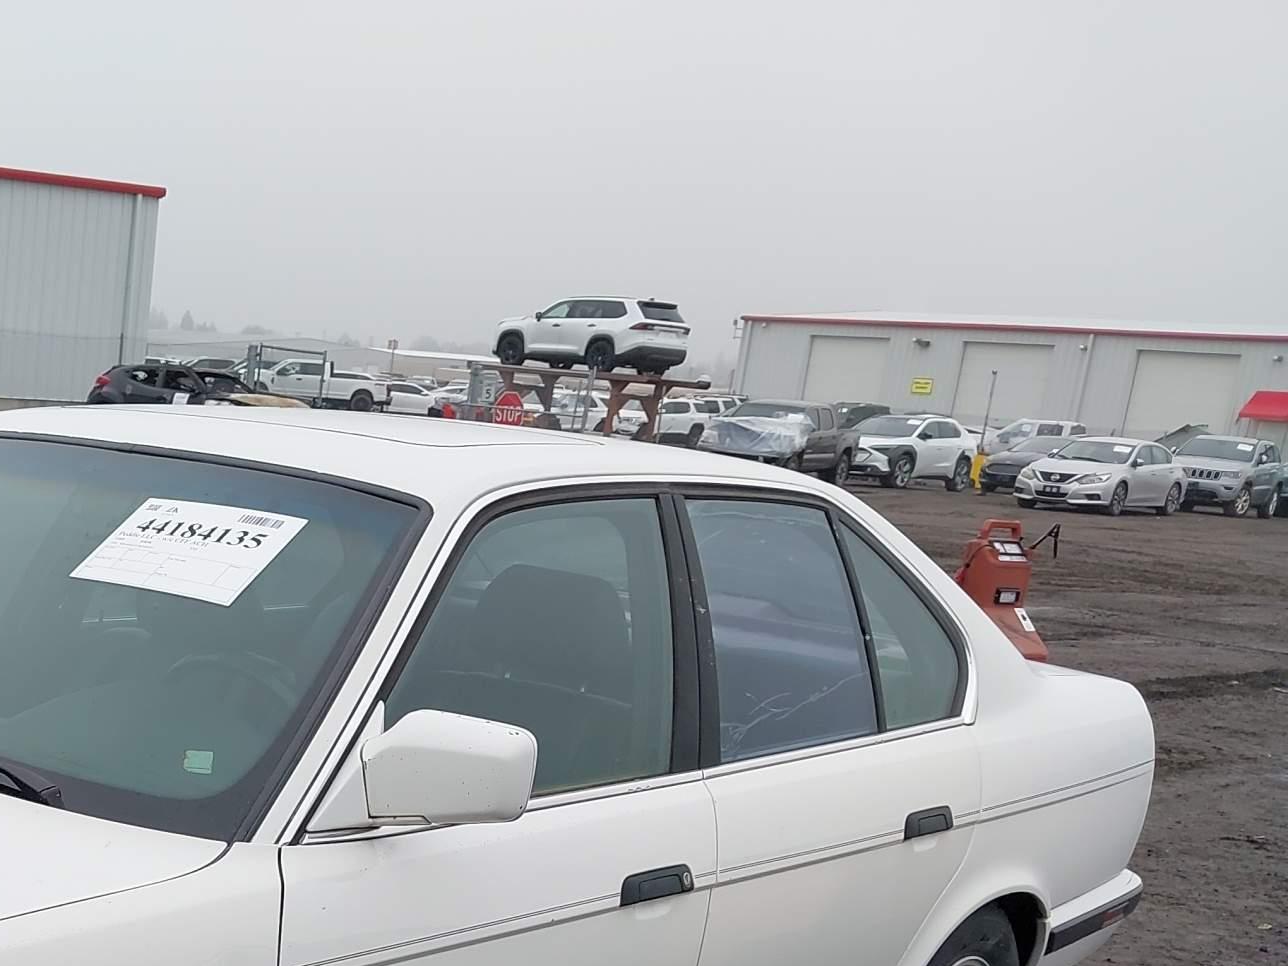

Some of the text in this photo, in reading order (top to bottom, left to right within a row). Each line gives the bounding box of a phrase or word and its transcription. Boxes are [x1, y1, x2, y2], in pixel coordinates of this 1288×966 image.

[485, 388, 492, 399] 5
[495, 405, 522, 422] STOP
[136, 518, 270, 549] 44184135
